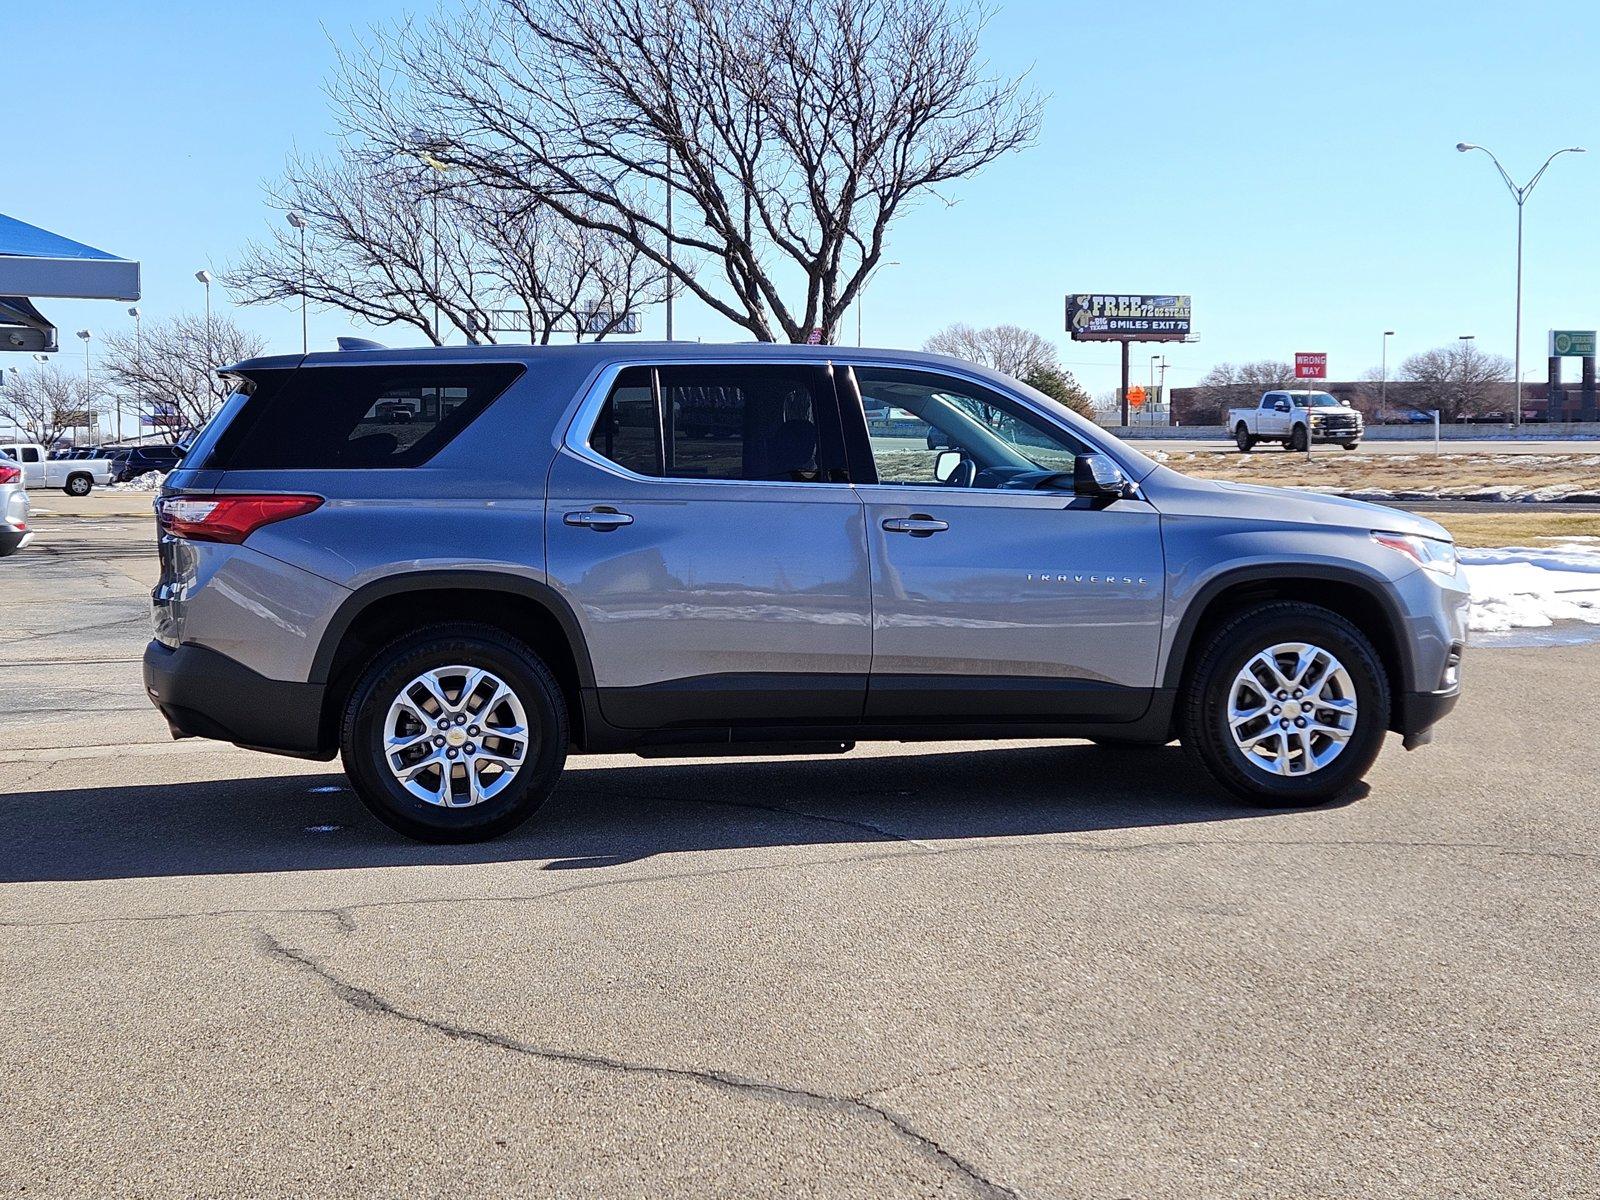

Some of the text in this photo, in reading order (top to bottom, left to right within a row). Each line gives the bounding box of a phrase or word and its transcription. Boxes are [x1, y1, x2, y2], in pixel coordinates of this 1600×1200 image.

[1092, 296, 1141, 316] FREE
[1141, 305, 1154, 317] 72
[1165, 308, 1190, 317] STEAK
[1095, 317, 1107, 325] BIG
[1110, 320, 1188, 330] 8 MILES EXIT 75
[1297, 355, 1326, 365] WRONG
[1302, 366, 1320, 375] WAY
[1026, 573, 1147, 584] TRAVERSE
